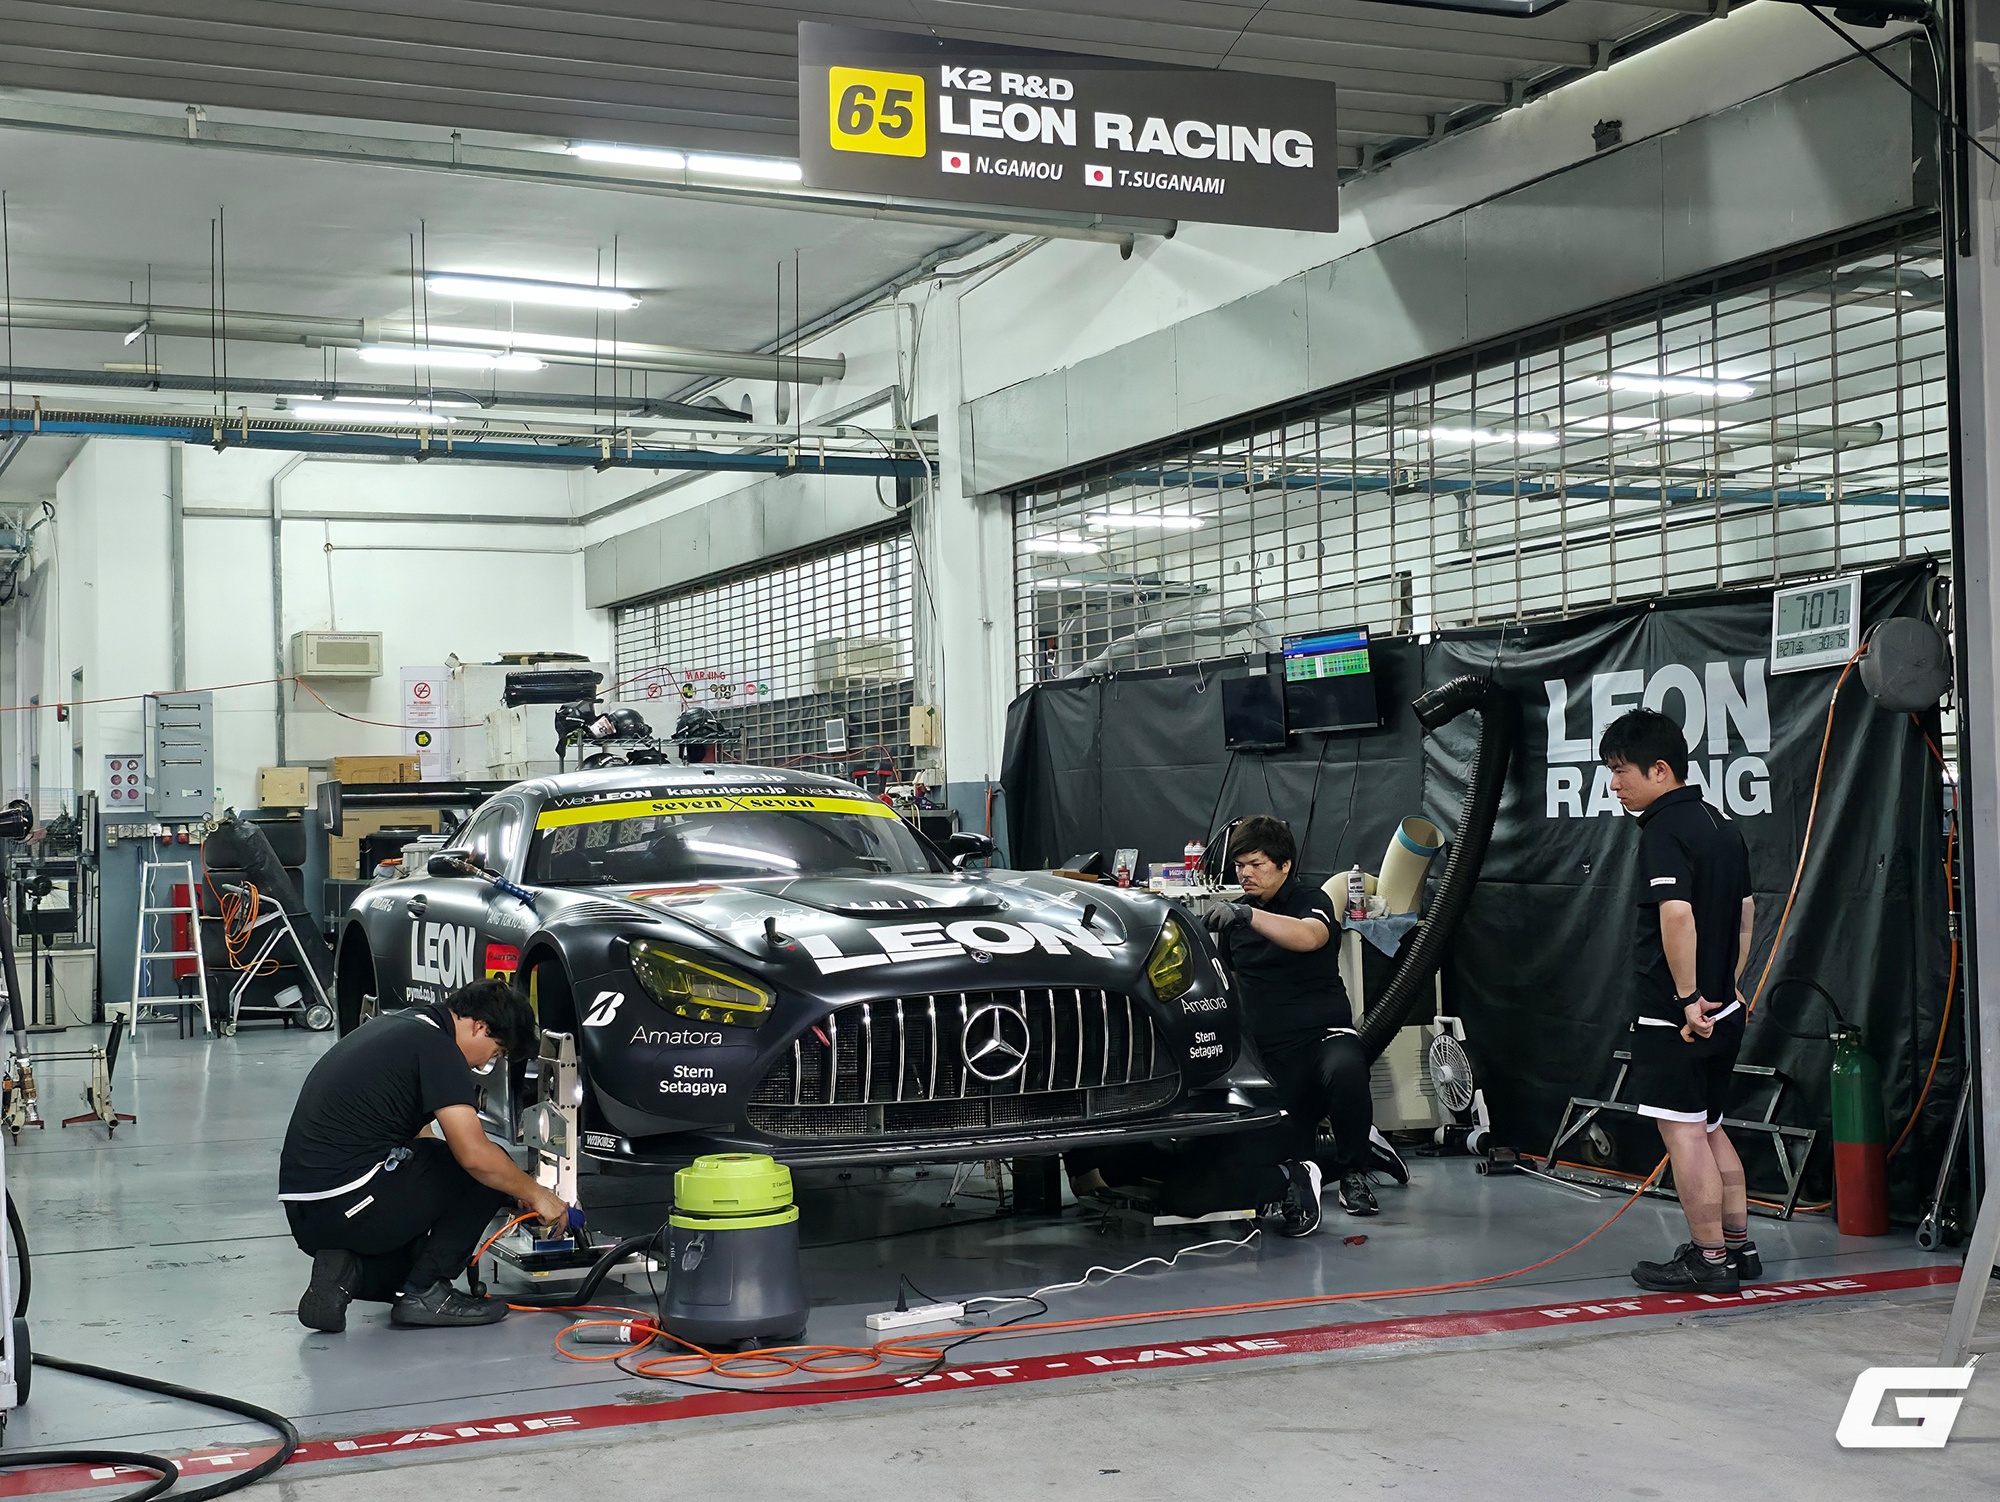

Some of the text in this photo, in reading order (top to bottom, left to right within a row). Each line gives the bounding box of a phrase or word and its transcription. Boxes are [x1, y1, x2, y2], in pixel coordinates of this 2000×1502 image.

[941, 65, 1074, 101] K2 R&D
[836, 84, 913, 139] 65
[939, 95, 1314, 169] LEON RACING
[975, 156, 1226, 195] N.GAMOU T.SUGANAMI
[666, 786, 787, 797] kaeruleon.jp
[411, 921, 476, 989] LEON
[800, 921, 1114, 975] LEON
[1181, 997, 1227, 1014] Amatora
[630, 1025, 722, 1045] Amatora
[1189, 1044, 1223, 1059] Setagaya
[1195, 1031, 1216, 1044] Stern
[659, 1080, 727, 1096] Setagaya
[673, 1065, 714, 1078] Stern
[1539, 1300, 1643, 1318] PIT
[1697, 1279, 1867, 1302] LANE
[1084, 1337, 1288, 1367] LANE
[333, 1415, 581, 1452] LANE
